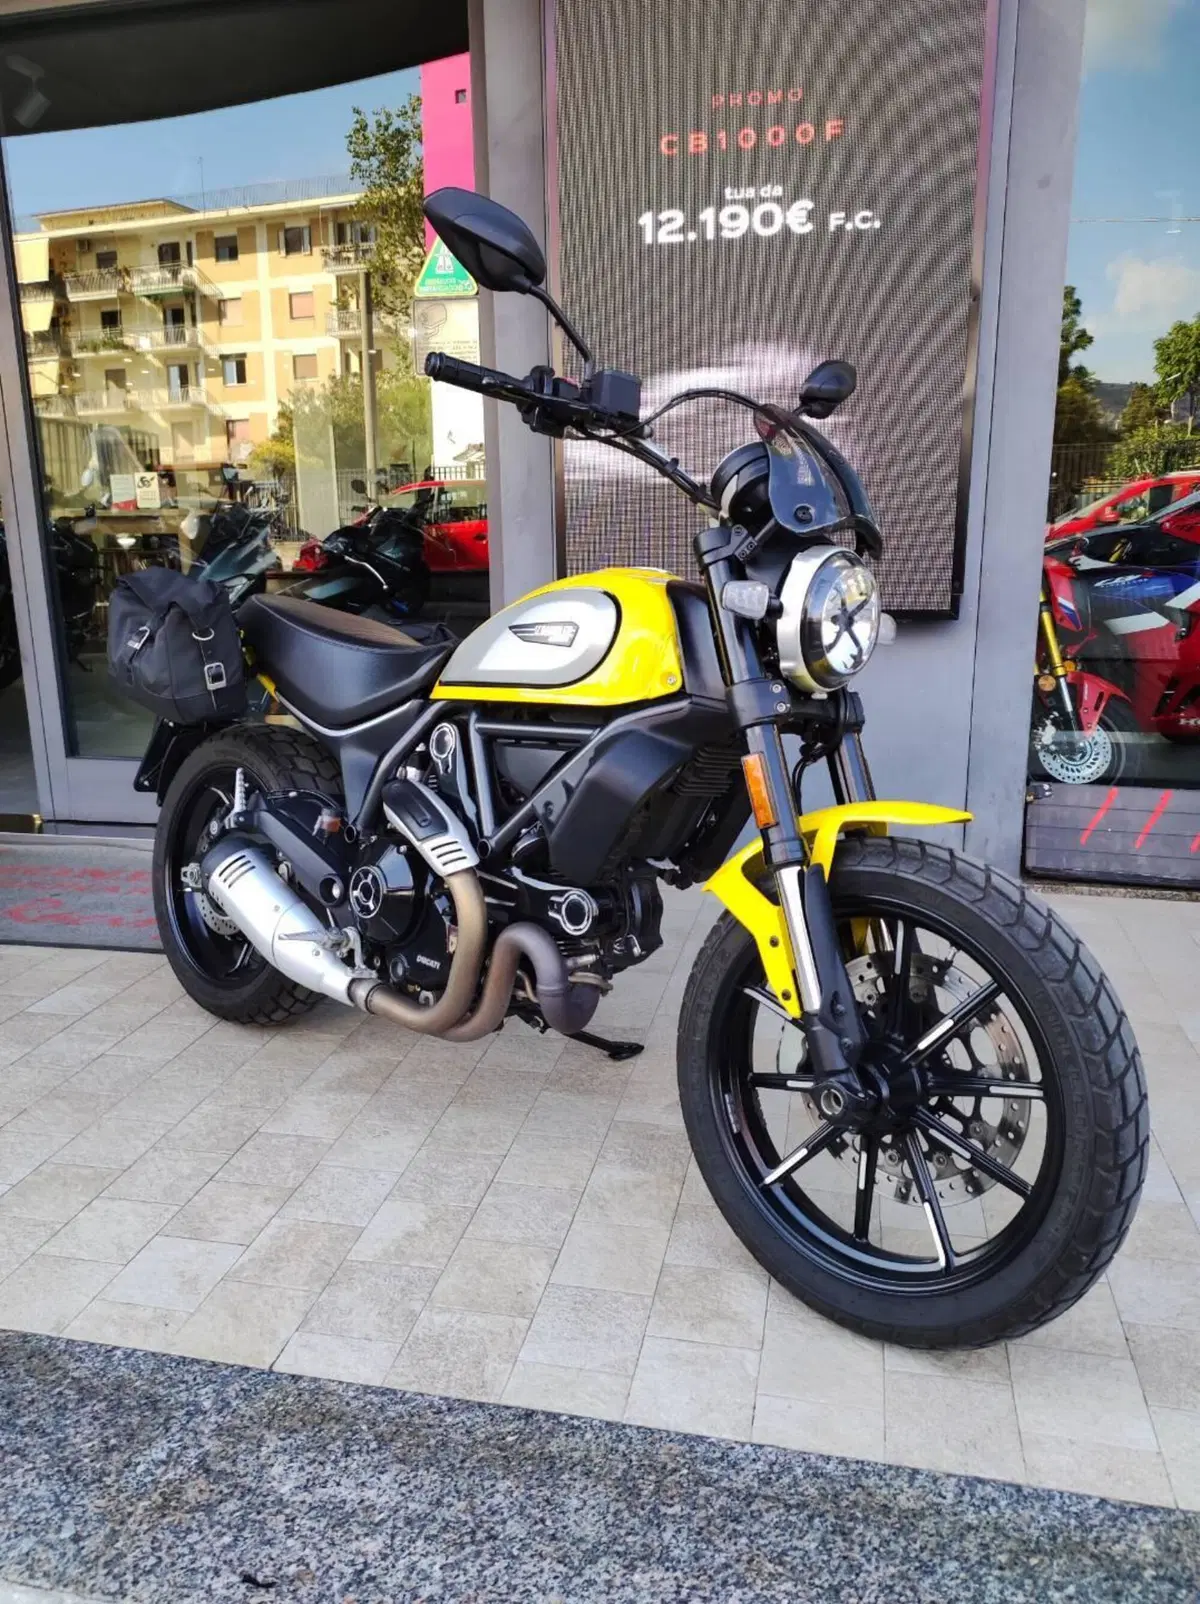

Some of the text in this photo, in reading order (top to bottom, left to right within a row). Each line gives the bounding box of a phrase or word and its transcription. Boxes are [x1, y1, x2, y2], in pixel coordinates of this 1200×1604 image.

[711, 87, 803, 108] PROMO
[659, 118, 845, 156] CB1000F
[724, 184, 783, 200] tua da
[637, 199, 882, 244] 12.190€ F.C.
